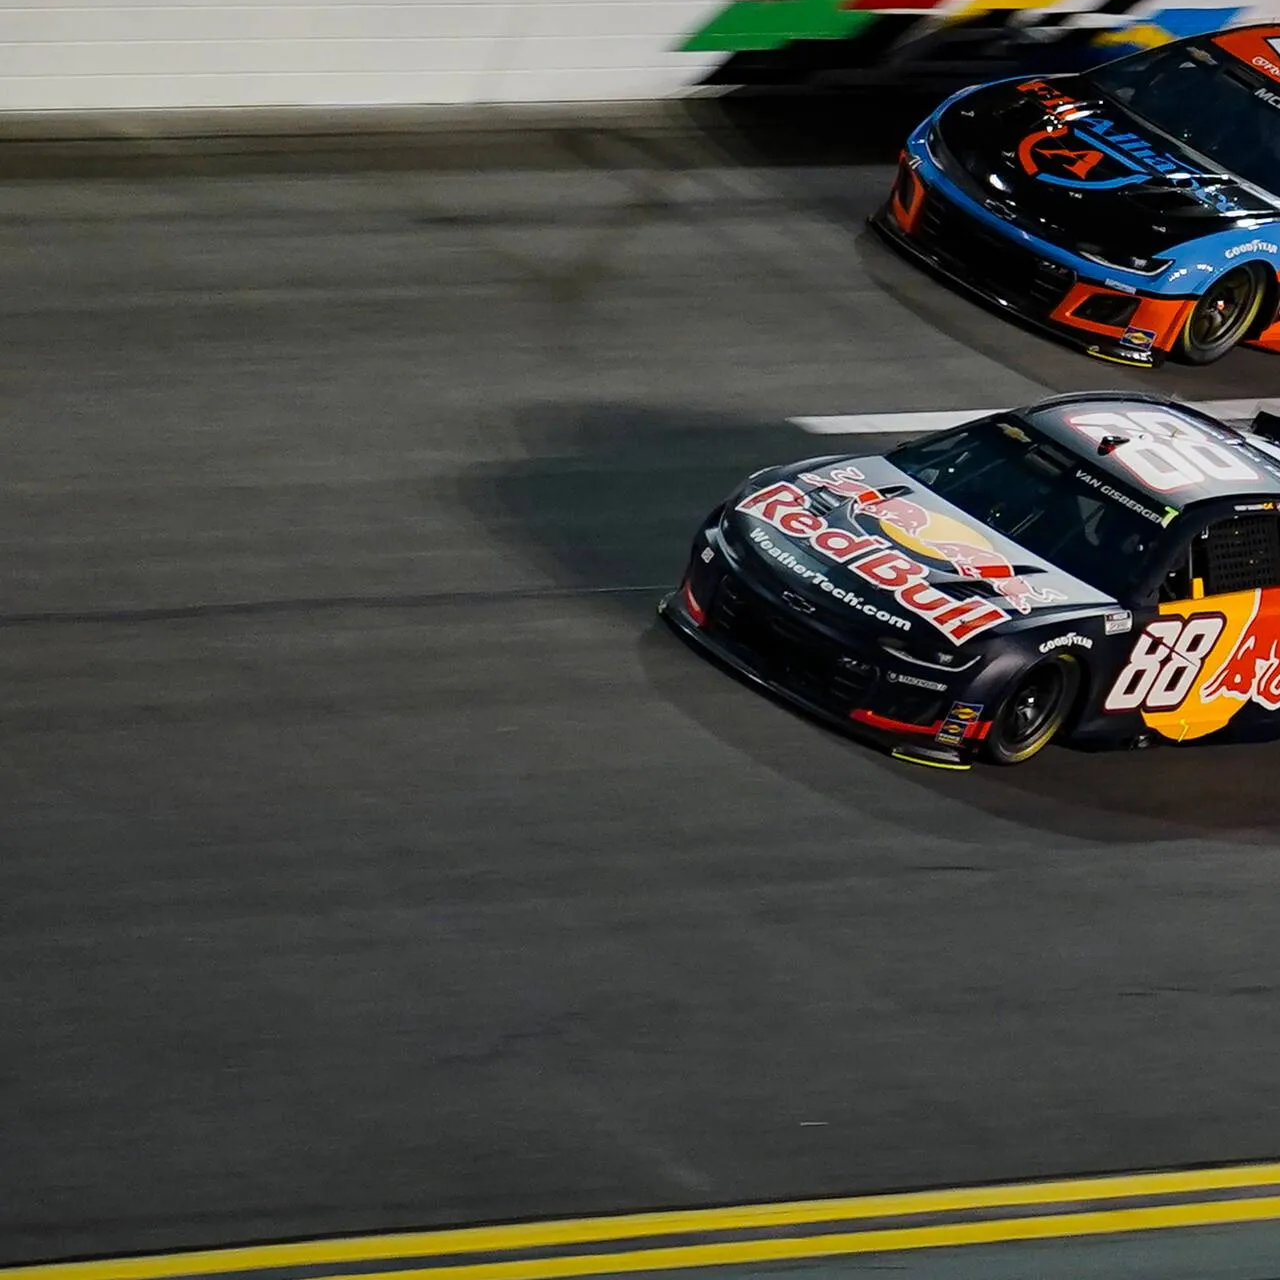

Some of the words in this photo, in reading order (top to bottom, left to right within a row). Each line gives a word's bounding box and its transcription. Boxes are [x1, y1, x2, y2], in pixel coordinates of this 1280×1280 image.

[1224, 239, 1279, 260] GOODYEAR
[1067, 411, 1263, 492] 88
[1074, 468, 1102, 489] VAN
[1039, 631, 1093, 654] GOODYEAR
[1104, 616, 1225, 711] 88
